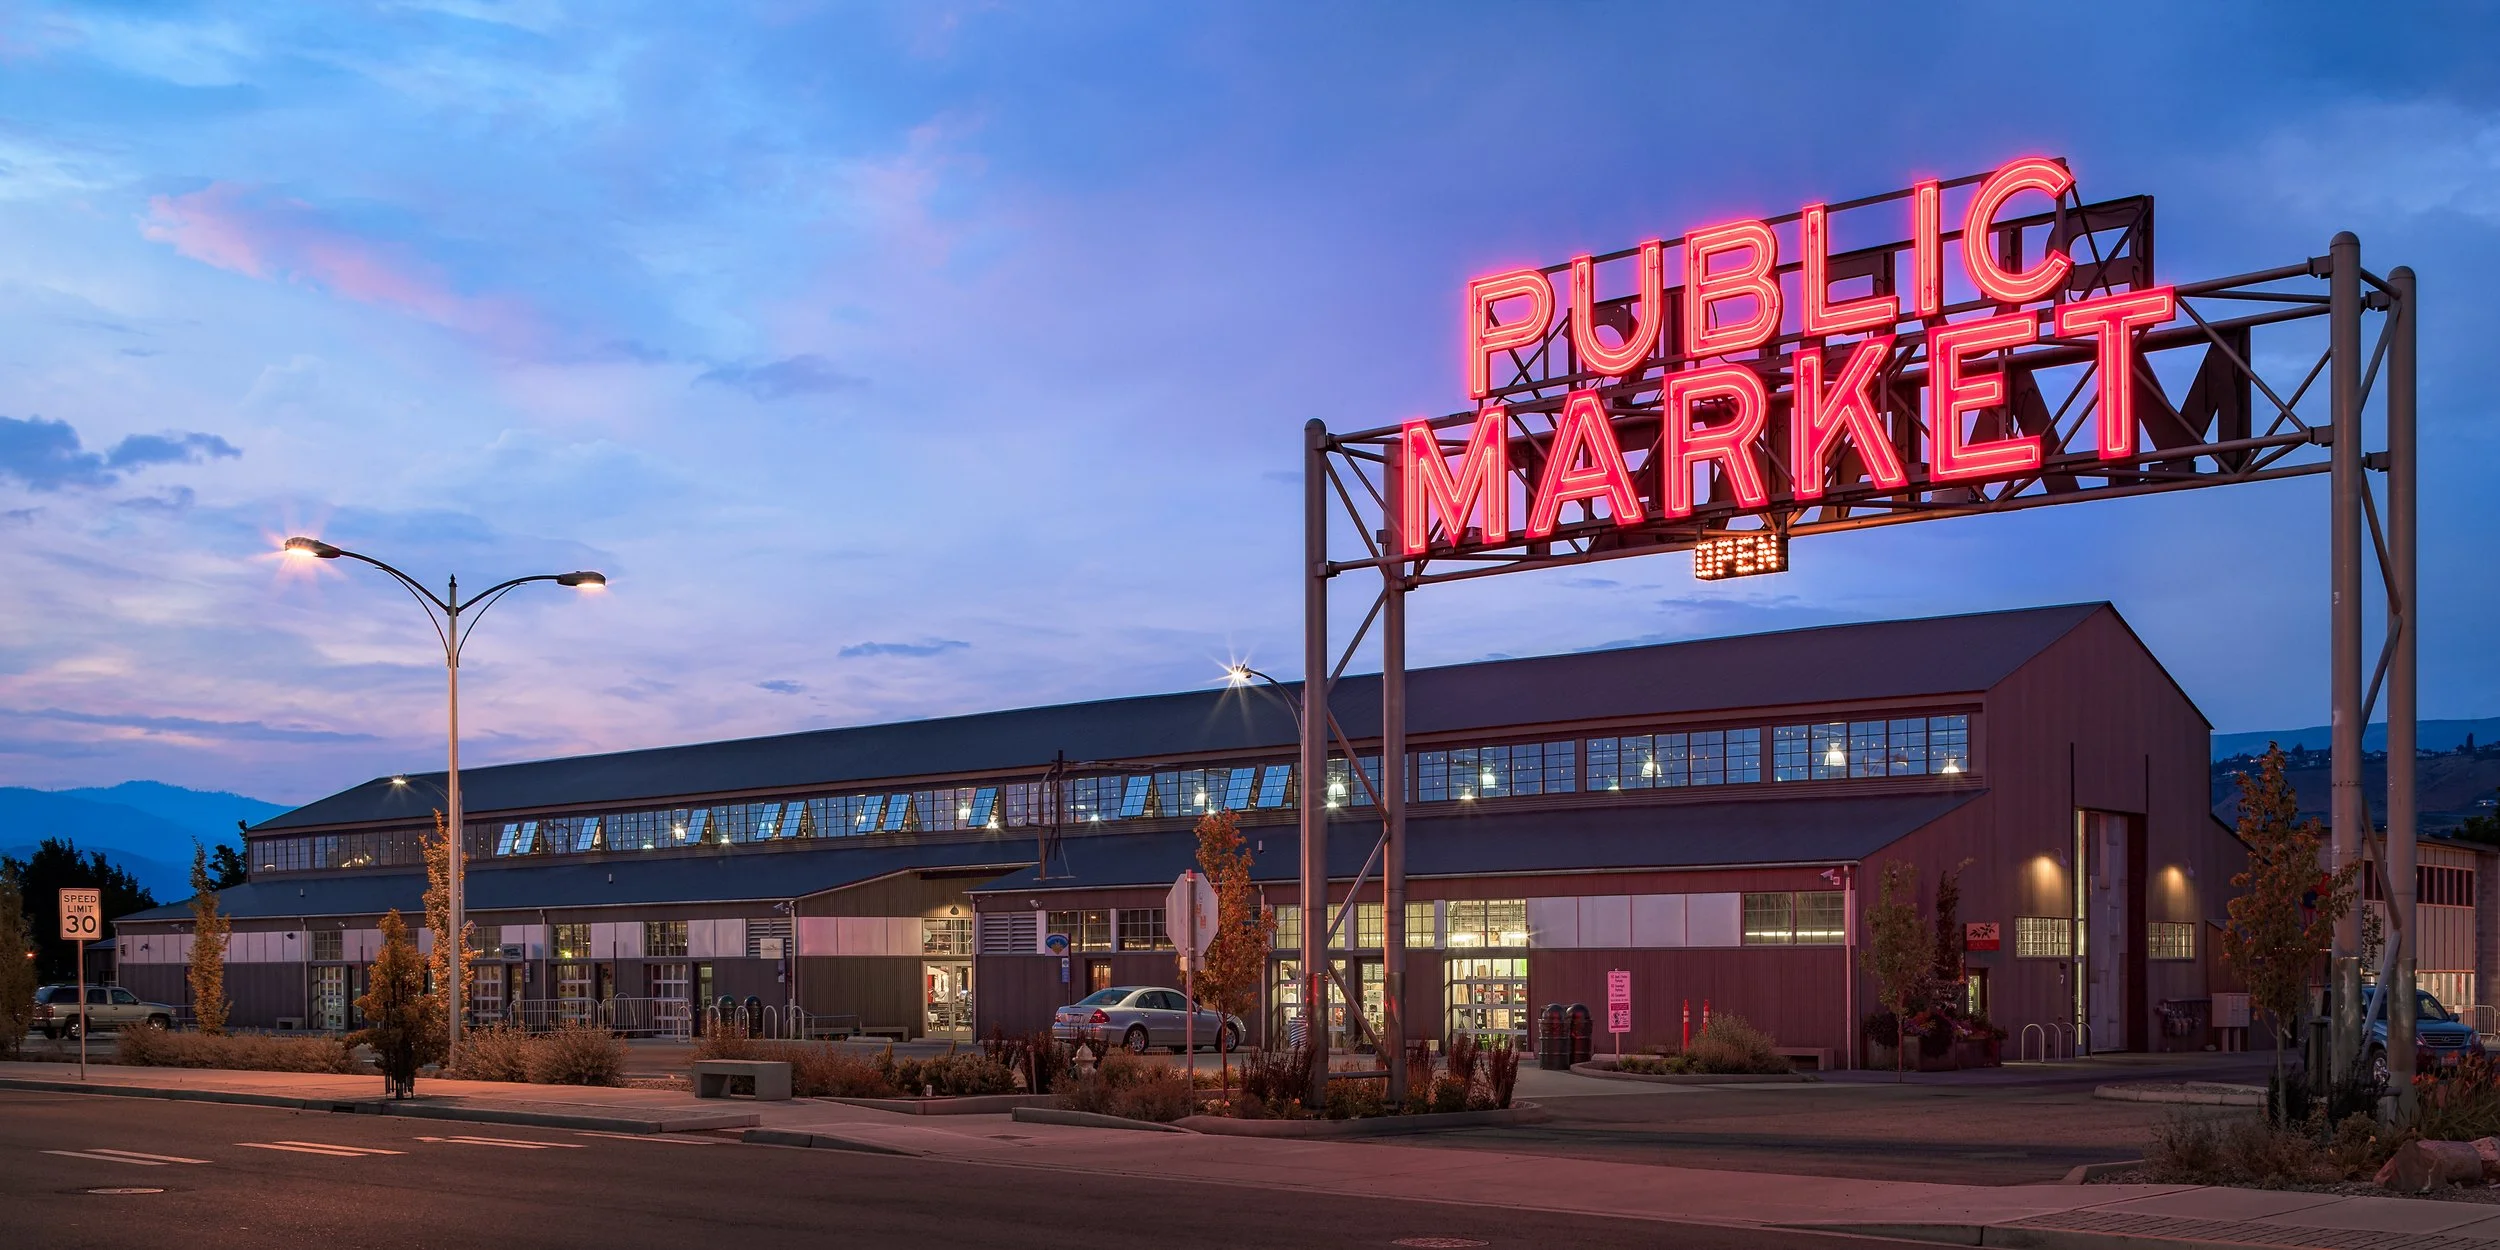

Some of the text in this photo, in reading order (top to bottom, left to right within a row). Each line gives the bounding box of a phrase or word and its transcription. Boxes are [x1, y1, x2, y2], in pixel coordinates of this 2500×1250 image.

[1468, 157, 2077, 400] PUBLIC
[1402, 285, 2176, 556] MARKET
[1696, 534, 1777, 577] OPEN
[63, 894, 97, 903] SPEED
[67, 905, 93, 913] LIMIT
[65, 915, 97, 933] 30
